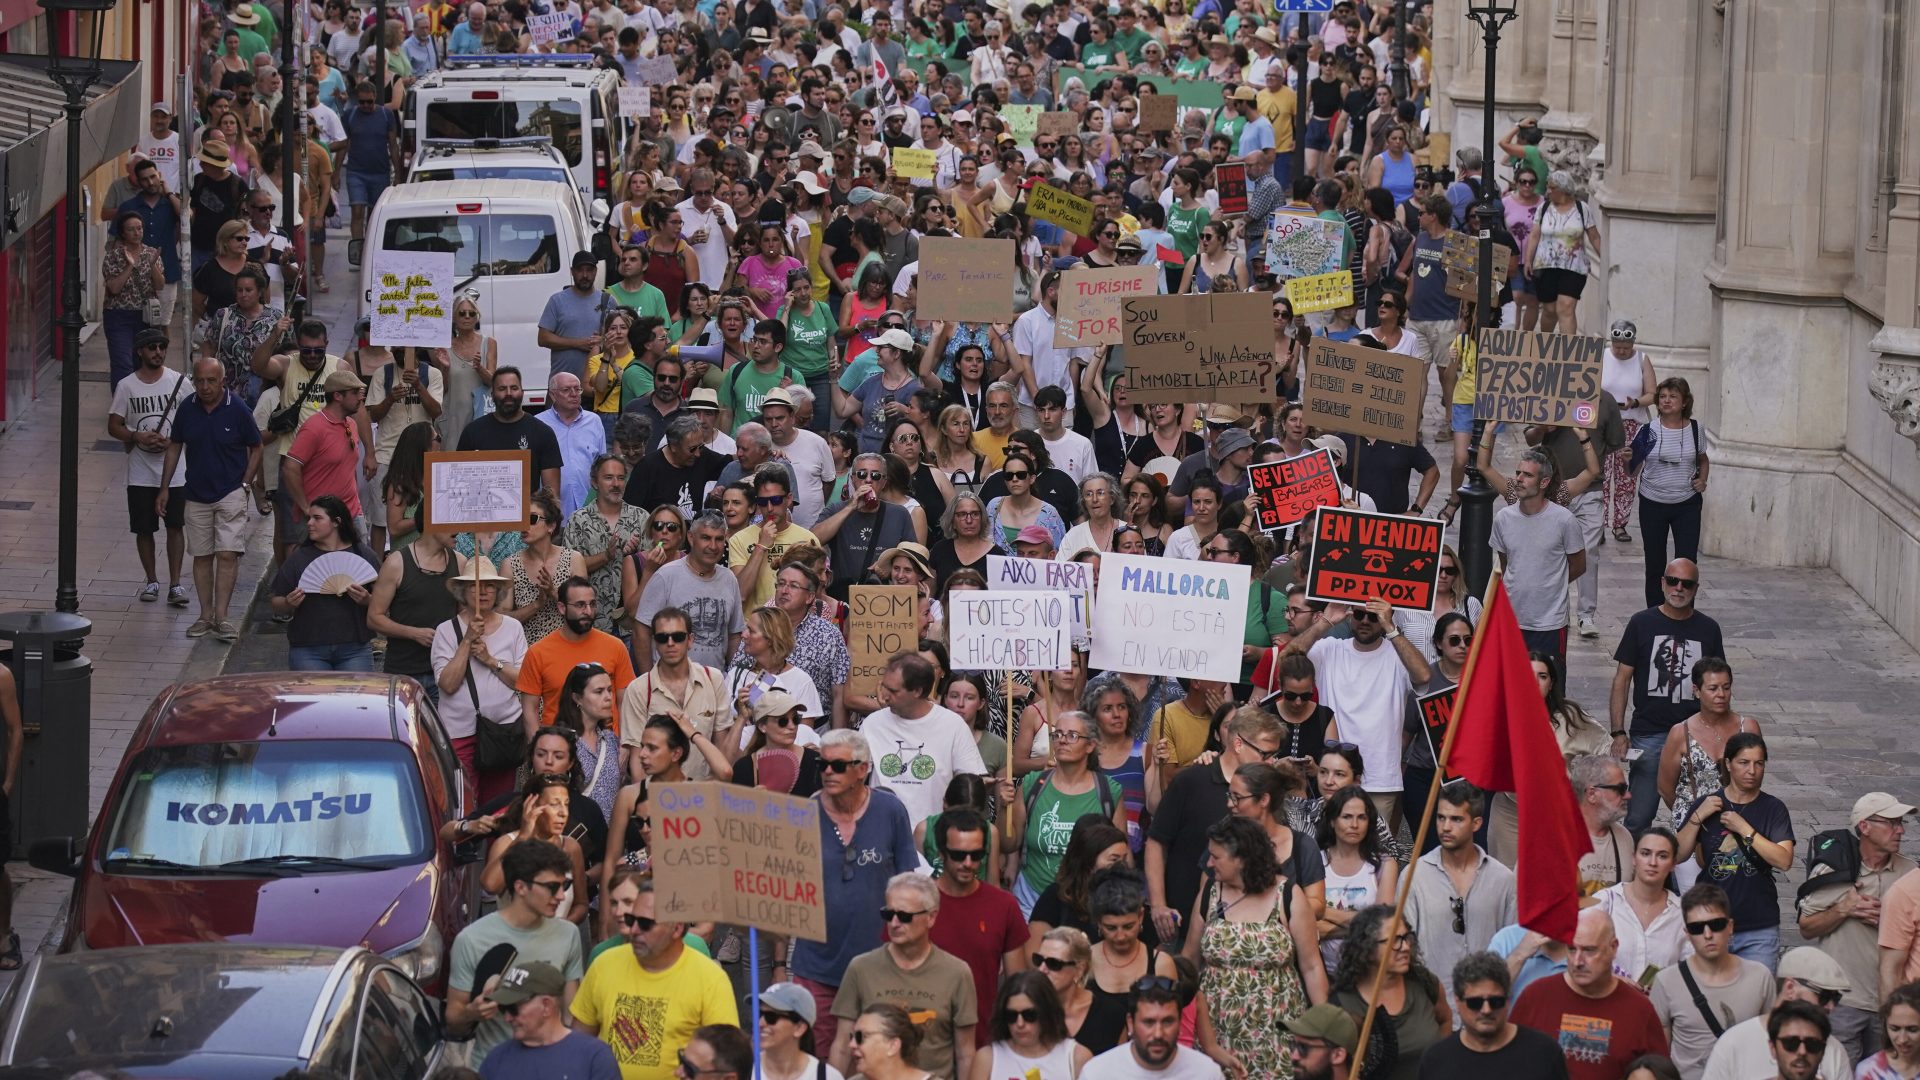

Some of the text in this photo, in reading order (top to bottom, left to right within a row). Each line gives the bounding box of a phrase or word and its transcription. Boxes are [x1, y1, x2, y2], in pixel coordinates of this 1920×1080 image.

[149, 147, 174, 157] SOS
[1033, 200, 1047, 212] ARA
[1037, 186, 1055, 203] ERA
[1276, 218, 1302, 239] SOS
[800, 327, 827, 338] CRIDA!
[1134, 325, 1186, 346] GOVERN
[1202, 345, 1273, 364] UNA AGÈNCIA
[1316, 346, 1404, 383] JOVES SENSE
[1310, 373, 1345, 393] CASA
[1370, 385, 1406, 405] ILLA
[1312, 398, 1351, 418] SENSE
[1474, 393, 1495, 419] NO
[1497, 396, 1549, 422] POSTS
[1253, 452, 1331, 489] SE VENDE
[1274, 474, 1333, 502] BALEARS
[1291, 494, 1328, 516] SOS
[1320, 513, 1438, 553] EN VENDA
[1046, 563, 1088, 589] FARÀ
[1121, 566, 1230, 600] MALLORCA
[1331, 577, 1416, 601] PP I VOX
[853, 594, 912, 617] SOM
[960, 597, 1062, 628] TOTES NO
[1122, 601, 1226, 635] NO ESTÀ
[851, 620, 914, 630] HABITANTS
[866, 633, 901, 654] NO
[991, 629, 1061, 670] CABEM!
[1122, 640, 1209, 674] EN VENDA
[166, 791, 372, 825] KOMATSU
[659, 788, 705, 812] Què
[720, 788, 757, 815] hem
[764, 799, 781, 819] de
[662, 816, 817, 858] NO VENDRE les
[663, 845, 731, 866] CASES
[734, 869, 817, 907] REGULAR
